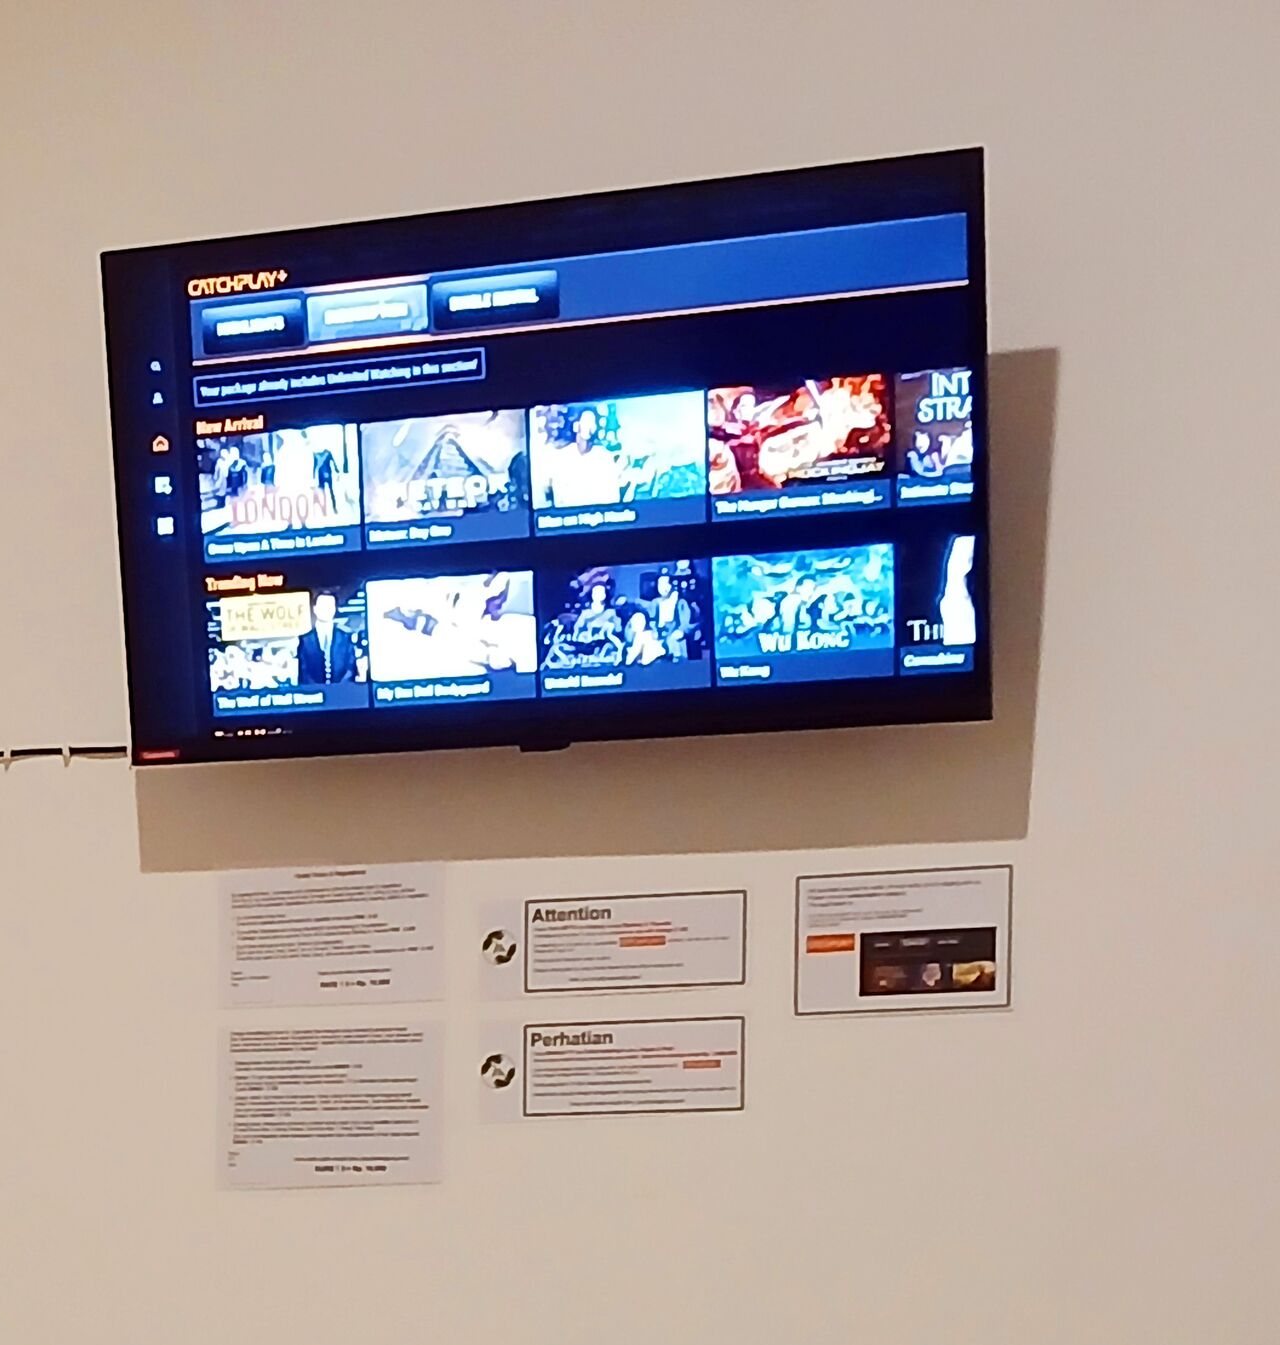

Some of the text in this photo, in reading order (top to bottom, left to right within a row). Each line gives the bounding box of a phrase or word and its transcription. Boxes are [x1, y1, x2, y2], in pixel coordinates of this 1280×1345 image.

[931, 370, 972, 397] INT
[224, 415, 264, 433] Arrival
[230, 487, 328, 526] LONDON
[205, 574, 284, 592] Trending Now
[226, 603, 305, 622] THE WOLF
[532, 906, 612, 923] Attention
[530, 1031, 613, 1047] Perhatian
